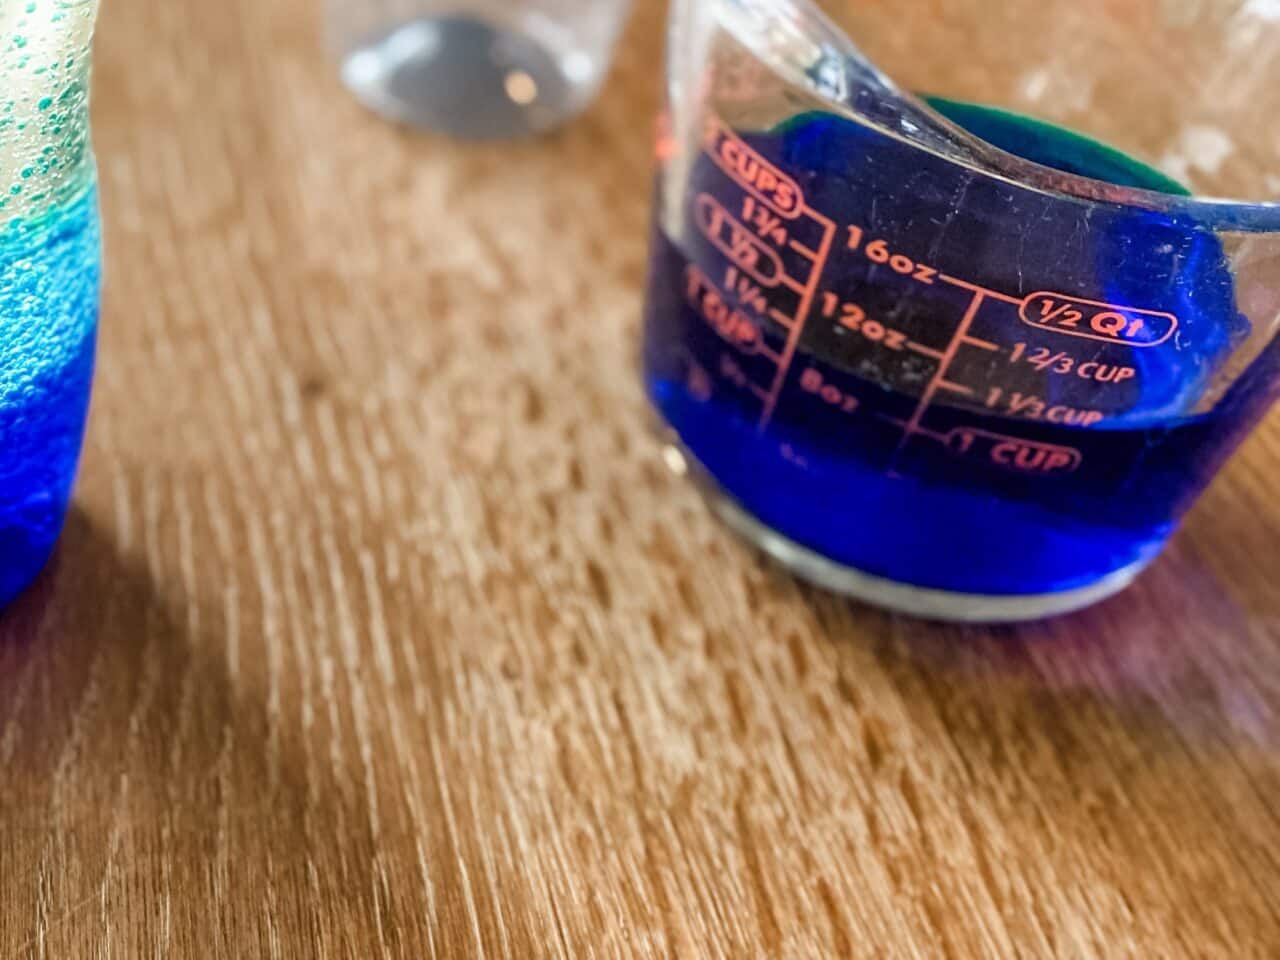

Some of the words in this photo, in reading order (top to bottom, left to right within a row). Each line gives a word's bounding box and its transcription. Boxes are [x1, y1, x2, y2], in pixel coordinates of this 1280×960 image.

[721, 140, 793, 209] CUPS
[847, 224, 938, 285] 16oz
[822, 292, 907, 351] 12oz
[1039, 299, 1083, 328] 1/2
[1089, 311, 1145, 338] Qt
[1076, 362, 1136, 383] CUP
[1046, 405, 1105, 428] CUP
[990, 442, 1072, 473] CUP
